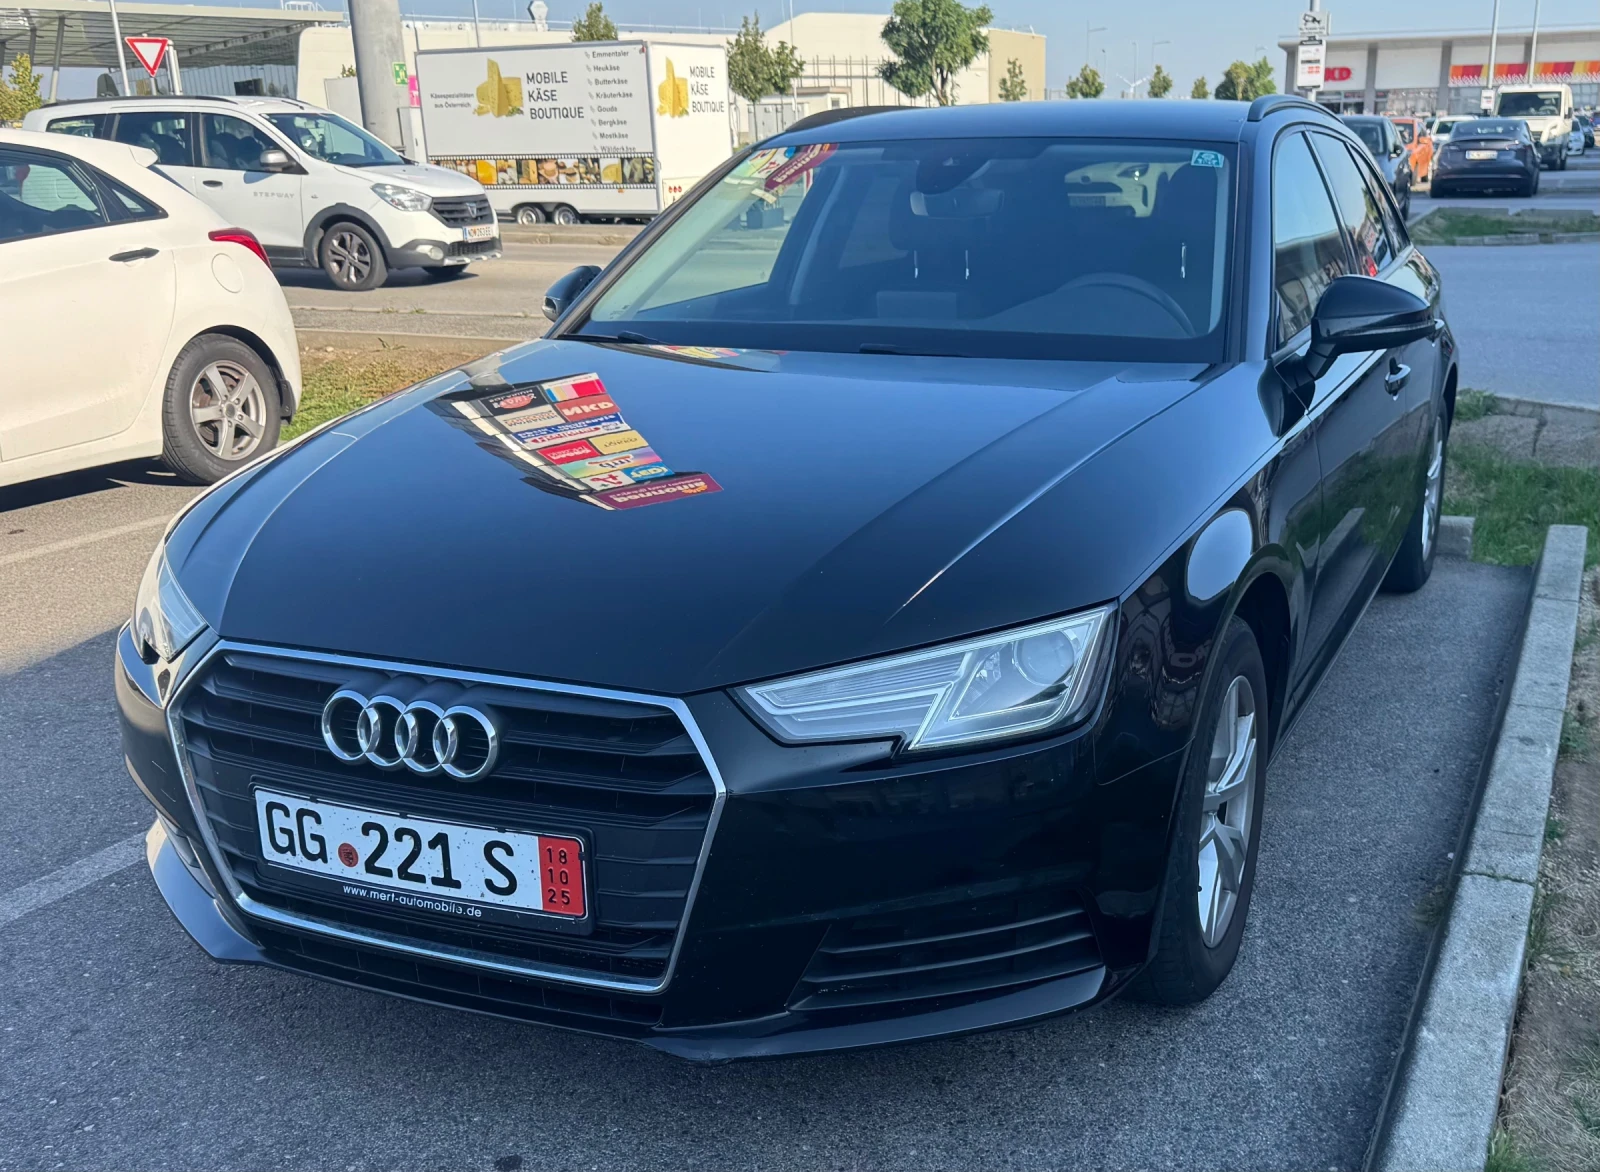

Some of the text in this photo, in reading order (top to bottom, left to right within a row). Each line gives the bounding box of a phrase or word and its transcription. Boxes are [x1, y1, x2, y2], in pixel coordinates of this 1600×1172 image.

[592, 50, 629, 58] Emmentaler
[593, 64, 620, 72] Heukäse
[689, 65, 716, 79] MOBILE
[526, 71, 568, 85] MOBILE
[594, 78, 628, 86] Butterkäse
[690, 81, 709, 96] KÄSE
[430, 92, 475, 100] Käsespezialitäten
[528, 87, 558, 102] KÄSE
[596, 91, 633, 99] Kräuterkäse
[444, 101, 472, 109] Österreich
[597, 105, 618, 113] Gouda
[692, 100, 725, 113] BOUTIQUE
[530, 106, 585, 120] BOUTIQUE
[598, 118, 628, 127] Bergkäse
[599, 132, 629, 140] Mostkäse
[253, 191, 295, 199] STEPWAY
[265, 801, 328, 864] GG
[361, 821, 462, 889] 221
[483, 840, 518, 896] S
[546, 846, 568, 865] 18
[547, 867, 569, 885] 10
[547, 887, 571, 905] 25
